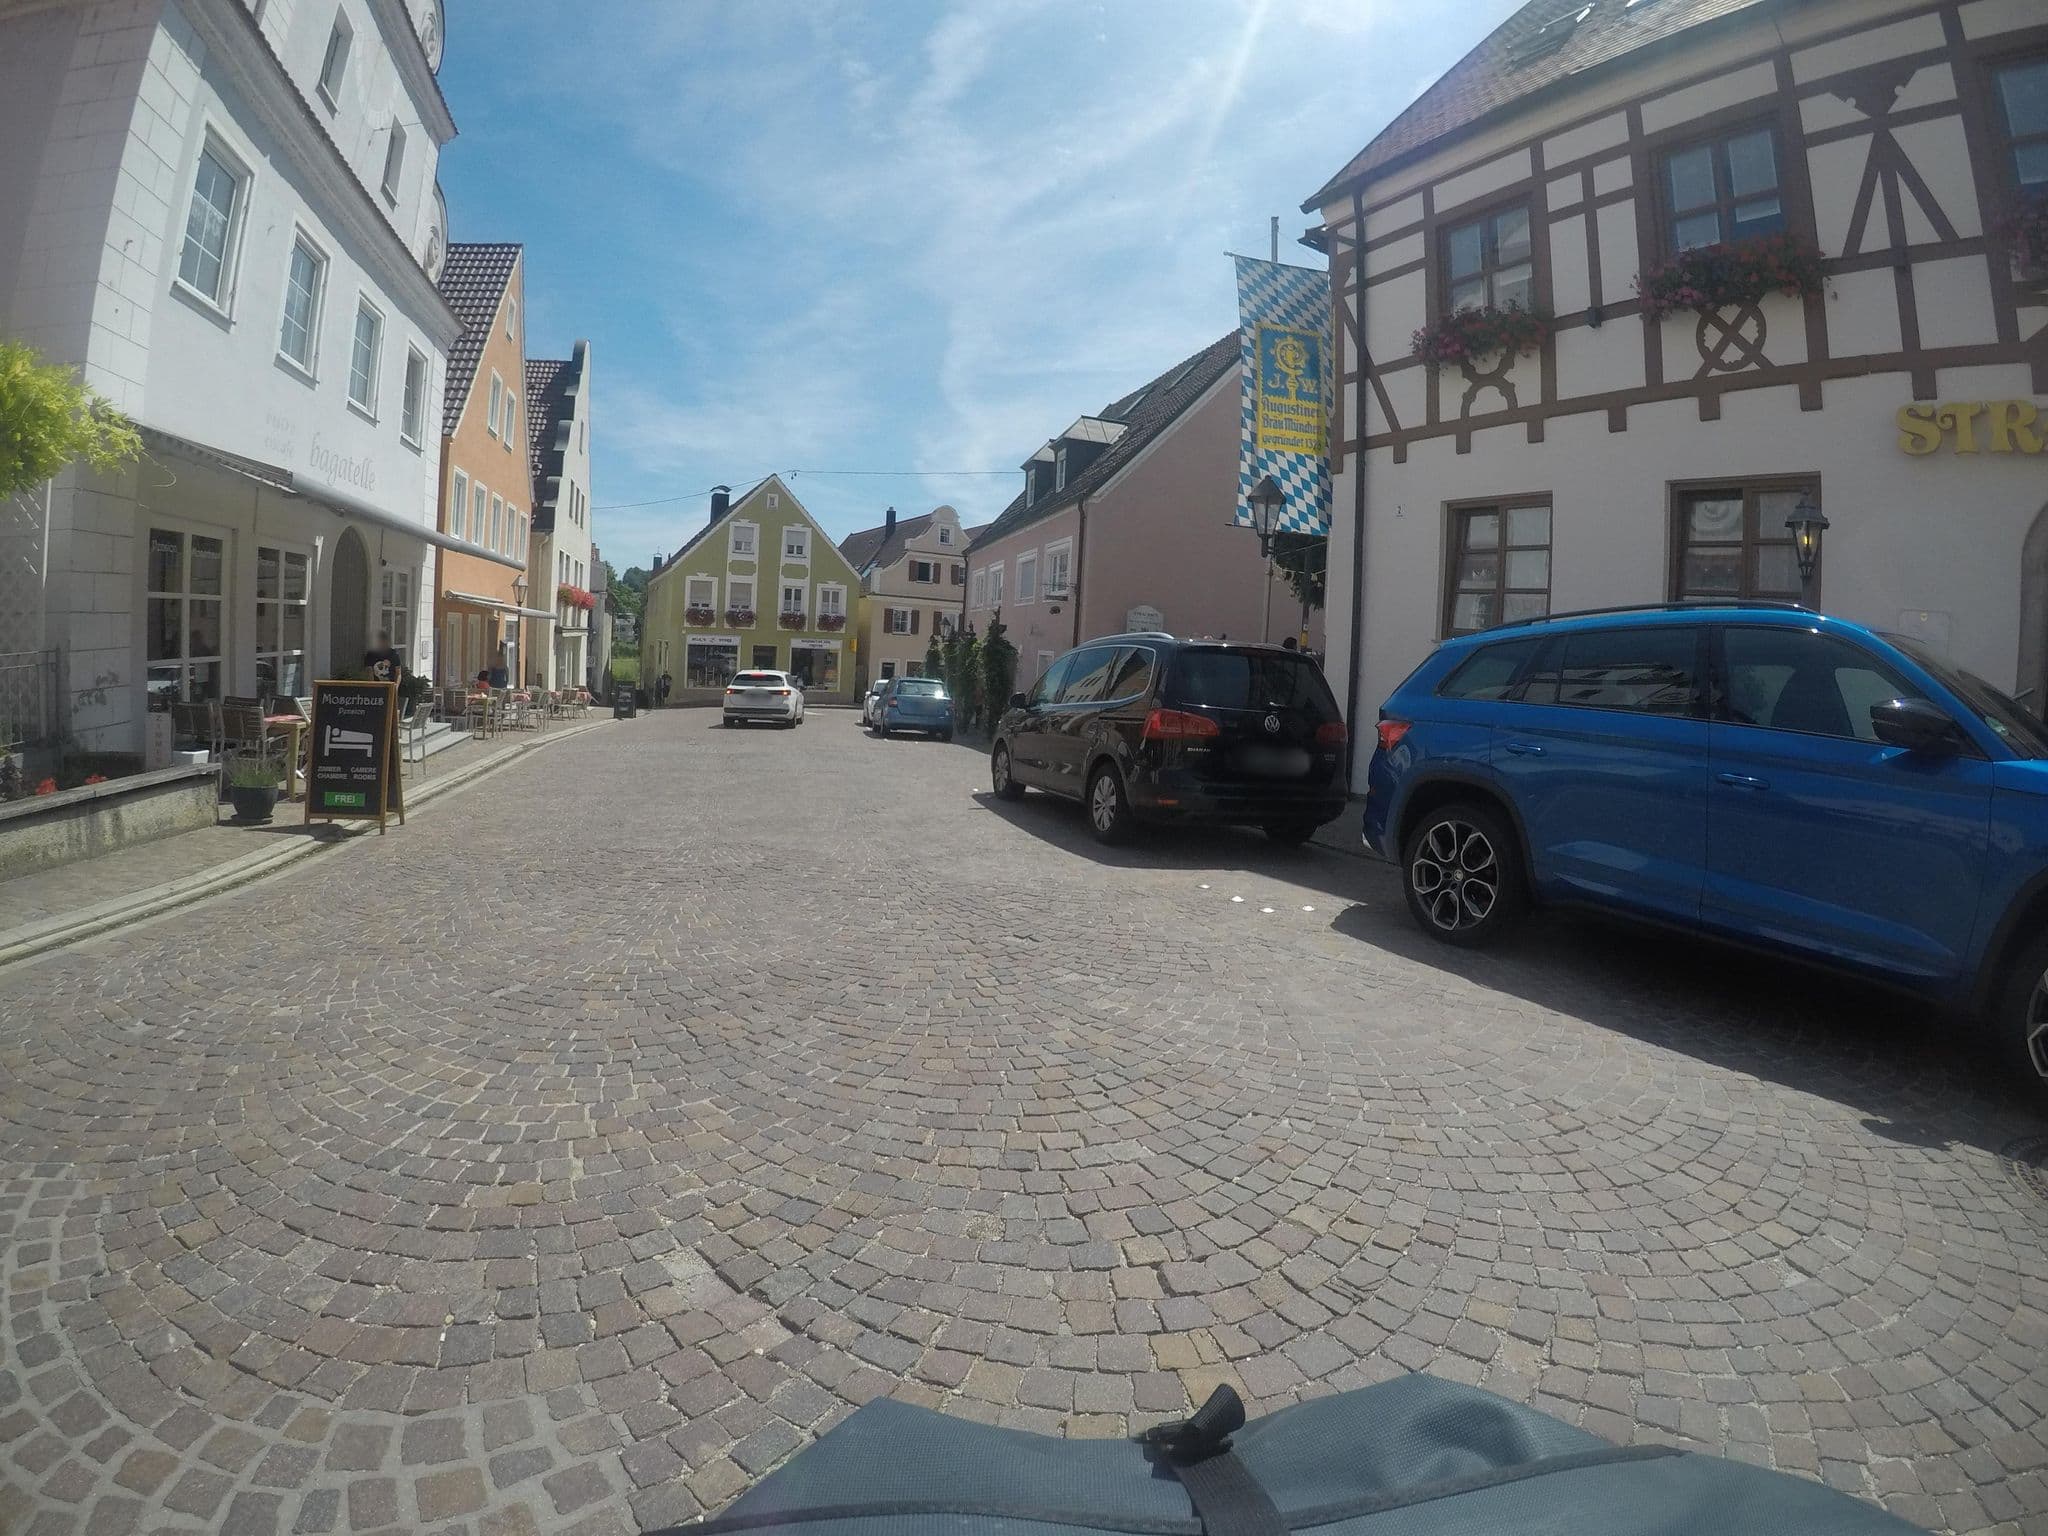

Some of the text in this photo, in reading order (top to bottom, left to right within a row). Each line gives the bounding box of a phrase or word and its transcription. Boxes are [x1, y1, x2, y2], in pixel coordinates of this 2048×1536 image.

[1262, 397, 1322, 418] Augustiner
[1262, 413, 1283, 430] Bräu
[1896, 401, 2048, 456] STR
[310, 431, 376, 491] bagatelle
[322, 694, 384, 706] Moserhaus
[334, 794, 356, 804] FREI
